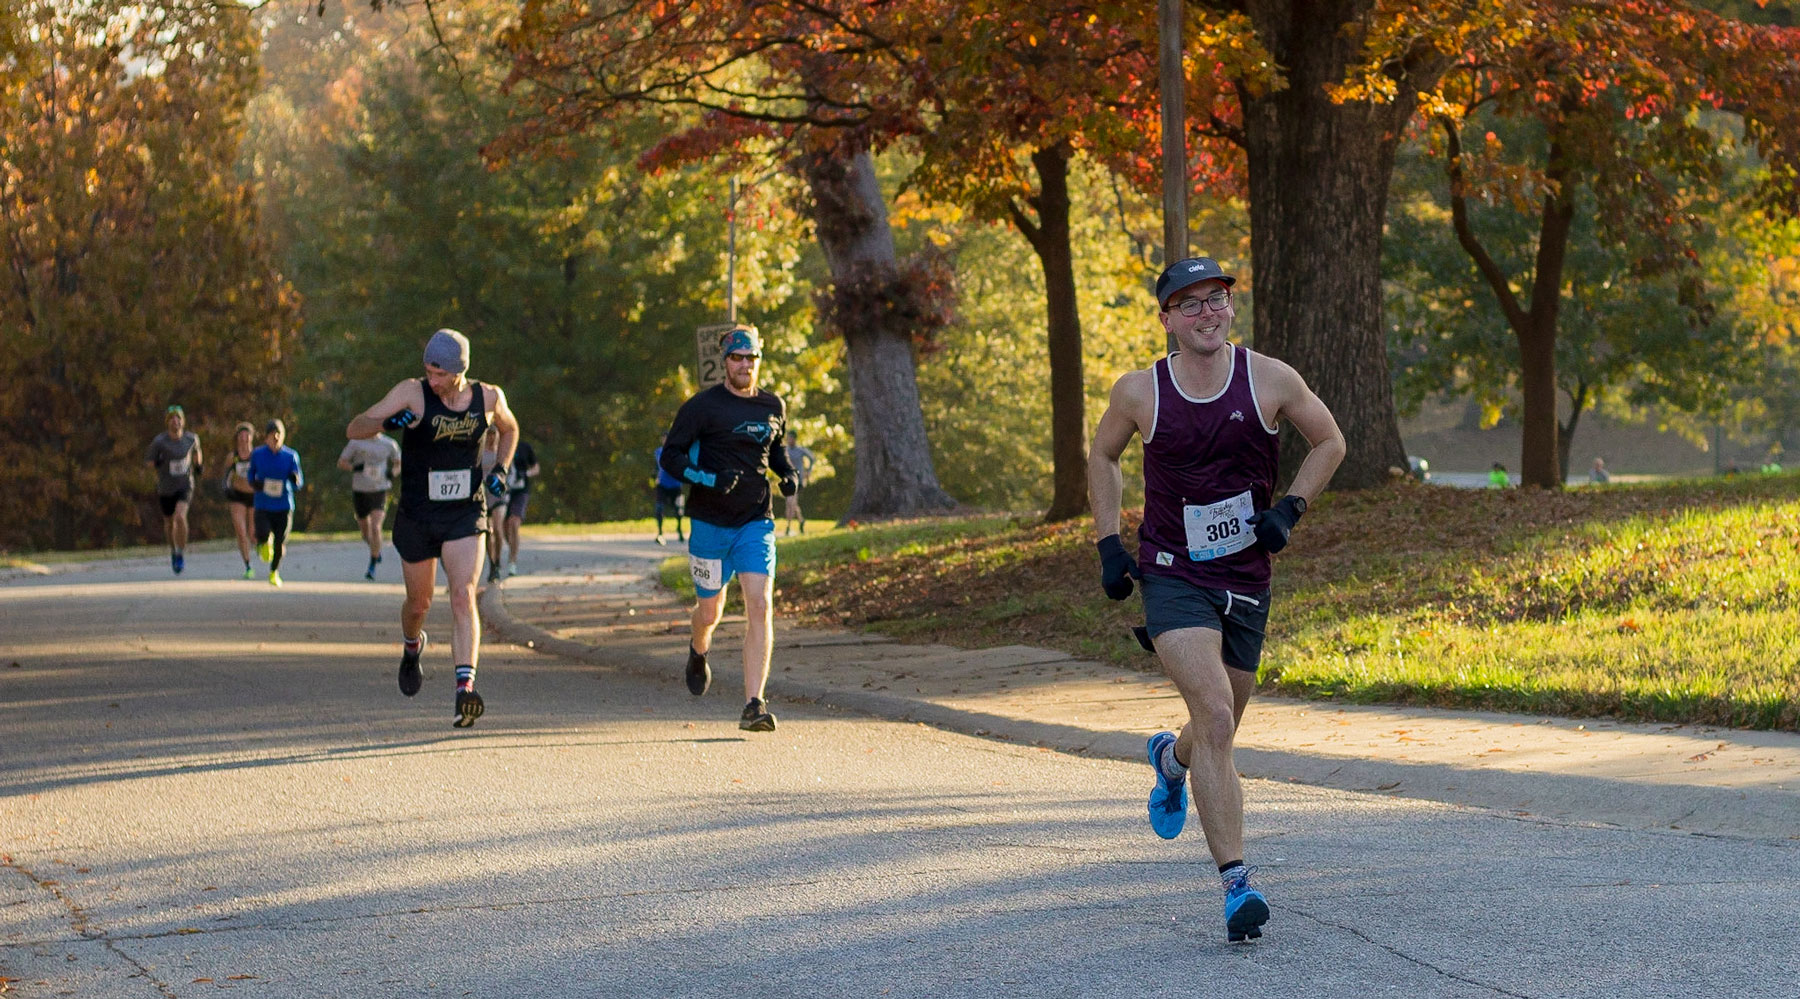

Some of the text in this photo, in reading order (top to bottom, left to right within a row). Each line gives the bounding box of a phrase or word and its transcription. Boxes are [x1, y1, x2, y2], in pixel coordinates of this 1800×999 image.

[432, 411, 479, 441] Trophy
[441, 483, 461, 496] 877
[1206, 517, 1241, 542] 303
